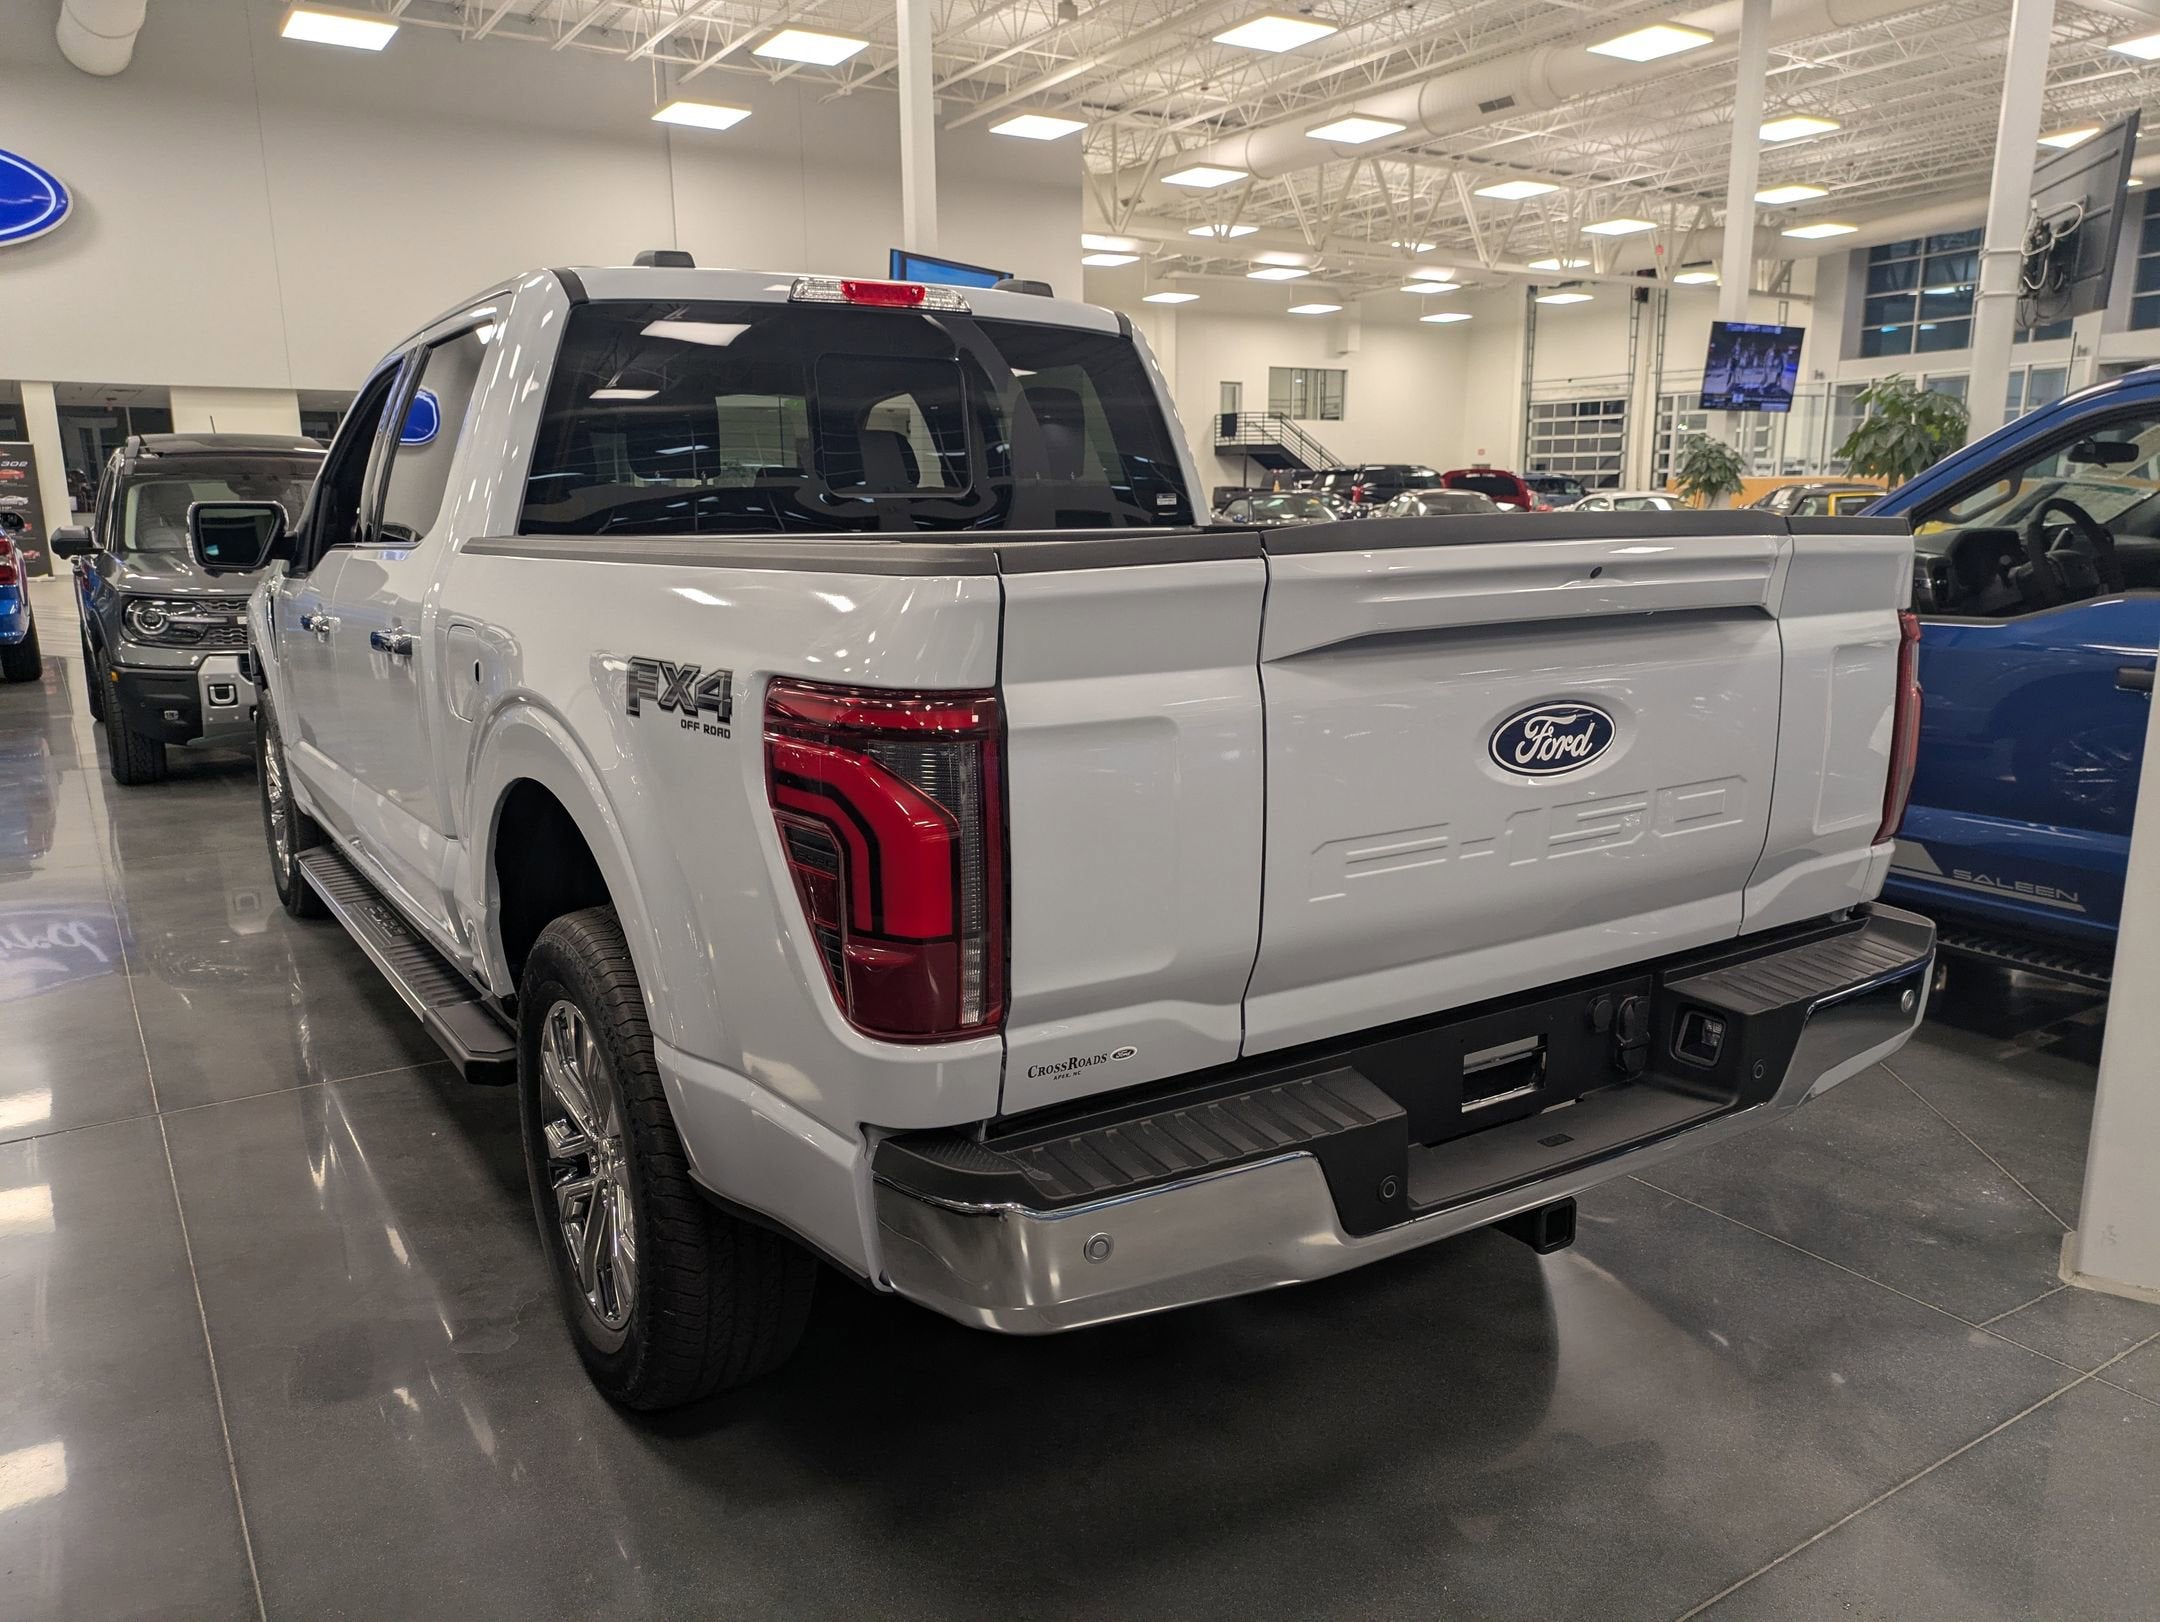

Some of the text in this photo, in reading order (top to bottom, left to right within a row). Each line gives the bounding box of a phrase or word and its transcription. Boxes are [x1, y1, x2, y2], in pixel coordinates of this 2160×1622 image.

[626, 656, 733, 724] FX4
[680, 719, 731, 739] OFF ROAD
[1515, 714, 1596, 764] Ford
[1308, 774, 1747, 904] F-150
[1952, 868, 2078, 902] SALEEN
